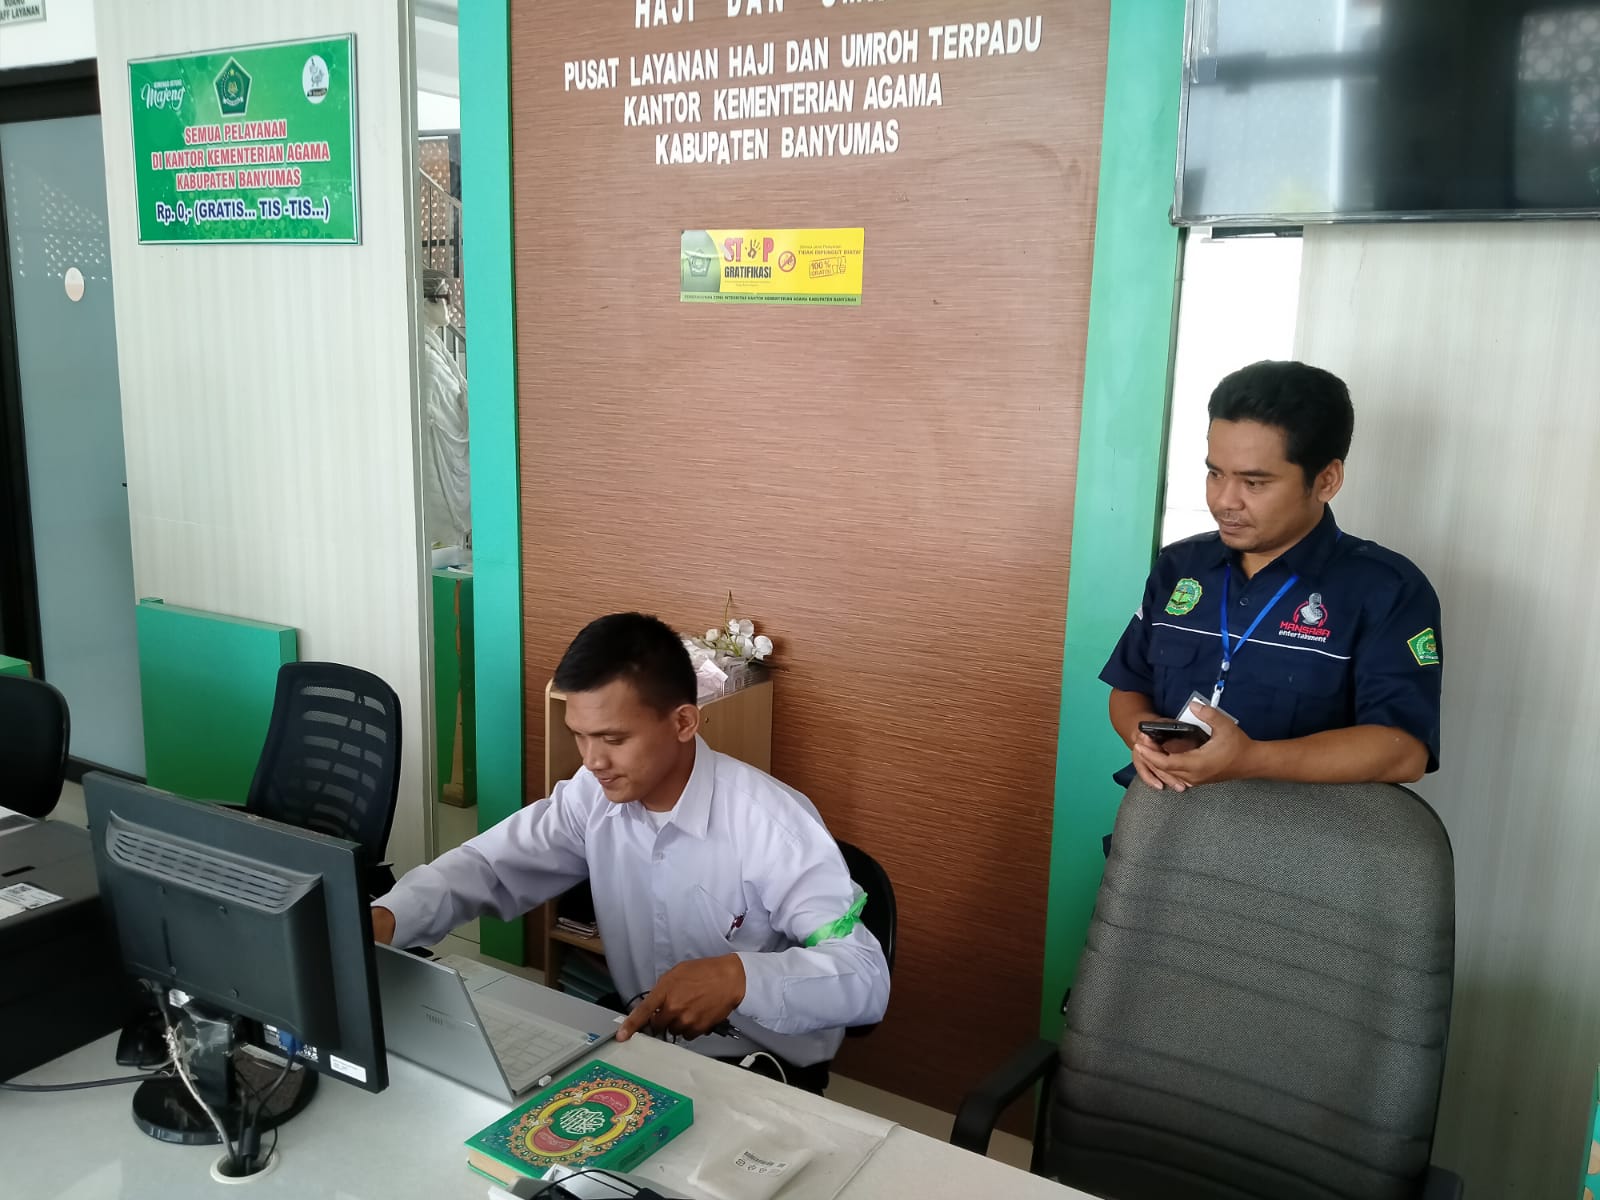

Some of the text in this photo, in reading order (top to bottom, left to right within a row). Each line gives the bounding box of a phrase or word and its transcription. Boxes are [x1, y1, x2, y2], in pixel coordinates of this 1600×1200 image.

[564, 15, 1042, 91] PUSAT LAYANAN HAJI DAN UMROH TERPADU
[624, 72, 942, 126] KANTOR KEMENTERIAN AGAMA
[185, 120, 287, 144] SEMUA PELAYANAN
[655, 119, 899, 165] KABUPATEN BANYUMAS
[152, 143, 330, 169] DI KANTOR KEMENTERIAN AGAMA
[176, 168, 301, 190] KABUPATEN BANYUMAS
[157, 202, 175, 223] Rp.
[259, 199, 281, 217] TIS
[724, 266, 772, 278] GRATIFIKASI
